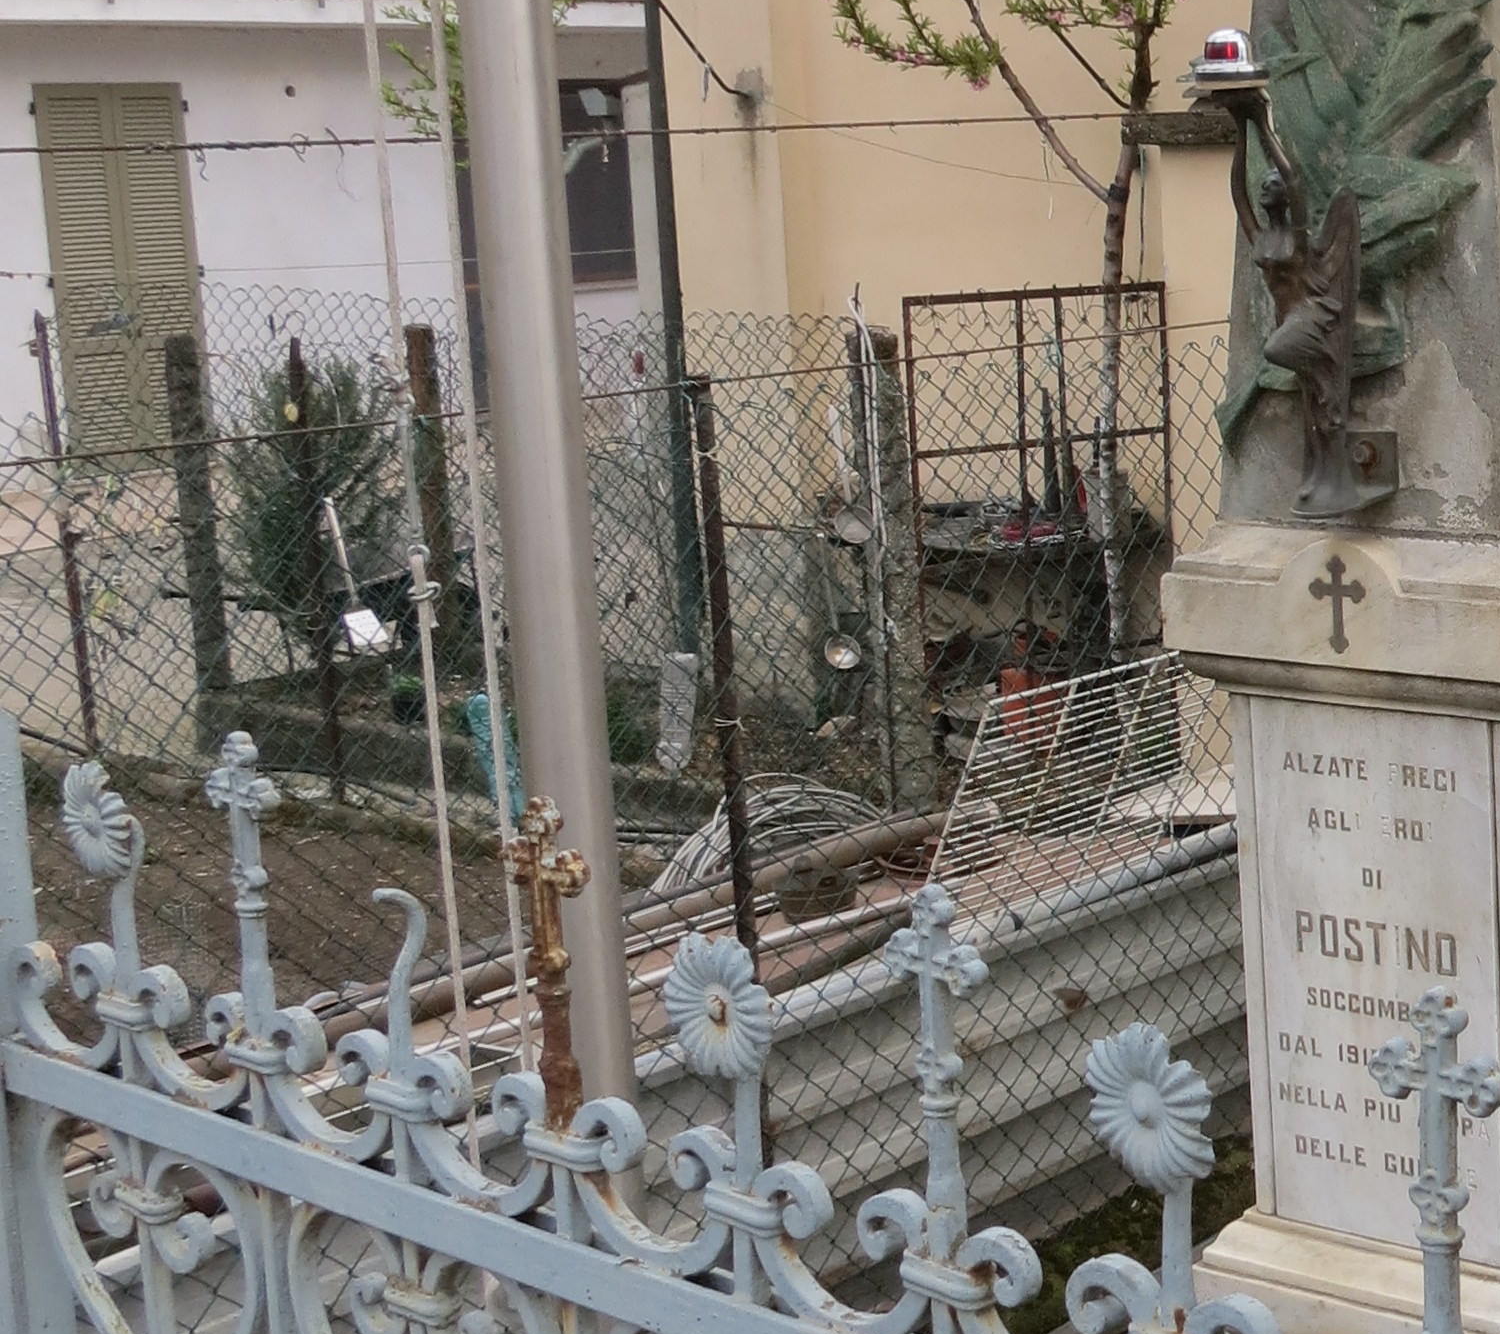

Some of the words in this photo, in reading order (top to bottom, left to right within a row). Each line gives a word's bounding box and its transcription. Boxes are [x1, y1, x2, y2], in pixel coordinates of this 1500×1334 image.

[1282, 751, 1369, 782] ALZATE
[1362, 867, 1383, 891] DI
[1295, 910, 1458, 978] POSTINO
[1306, 986, 1412, 1023] SOCCOMB
[1278, 1031, 1323, 1059] DAL
[1338, 1042, 1378, 1066] 191
[1278, 1082, 1348, 1114] NELLA
[1364, 1097, 1402, 1124] PIU
[1295, 1134, 1367, 1167] DELLE
